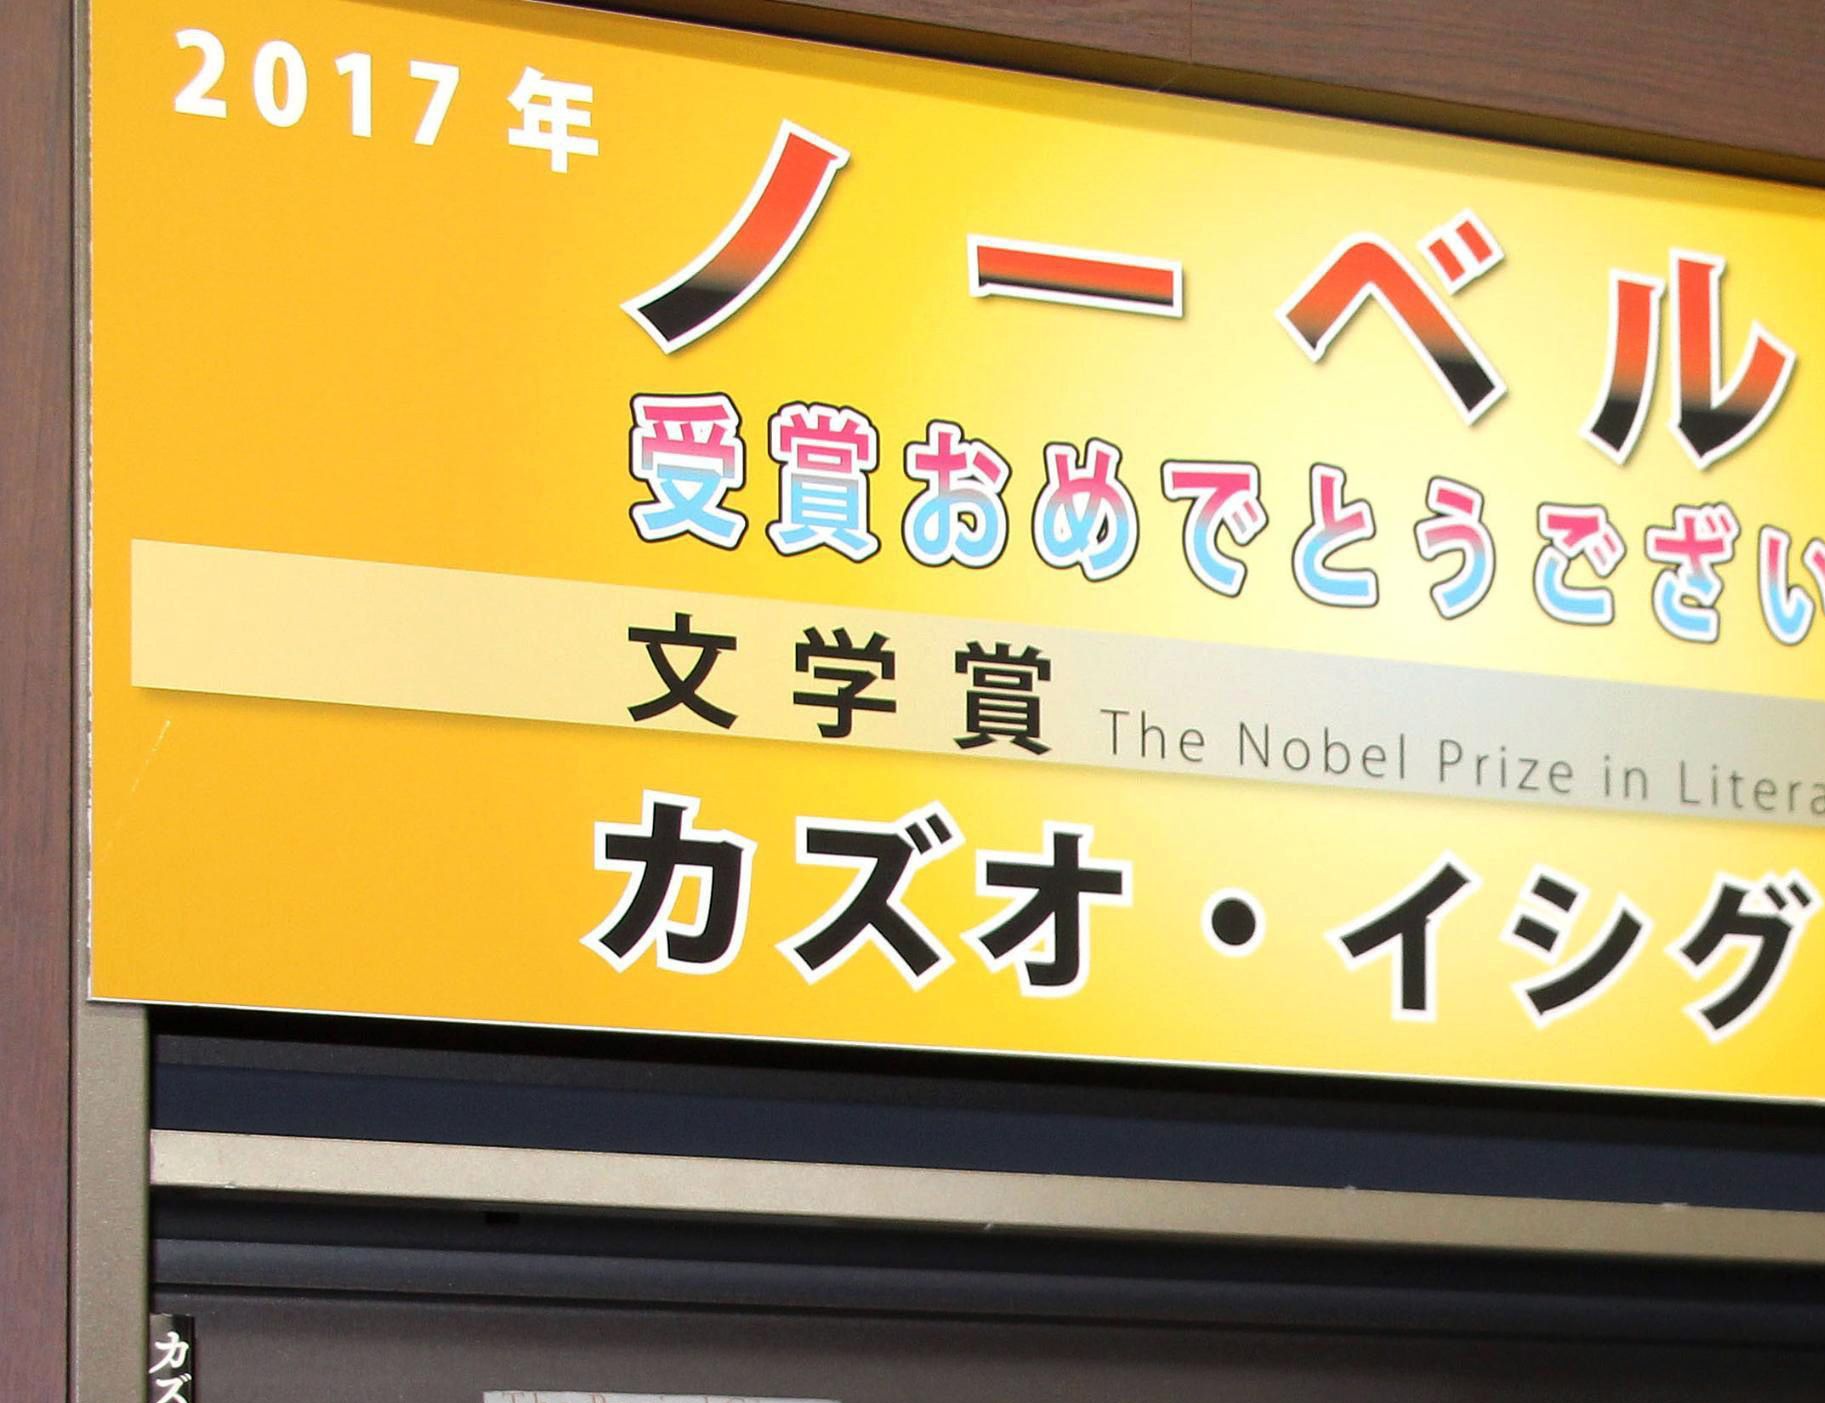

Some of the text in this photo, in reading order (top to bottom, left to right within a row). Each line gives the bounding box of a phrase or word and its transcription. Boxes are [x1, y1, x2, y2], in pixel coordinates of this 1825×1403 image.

[626, 611, 1055, 756] 文学賞
[1100, 705, 1208, 766] The
[1236, 718, 1410, 783] Nobel
[1439, 734, 1576, 796] Prize
[1602, 751, 1650, 800] in
